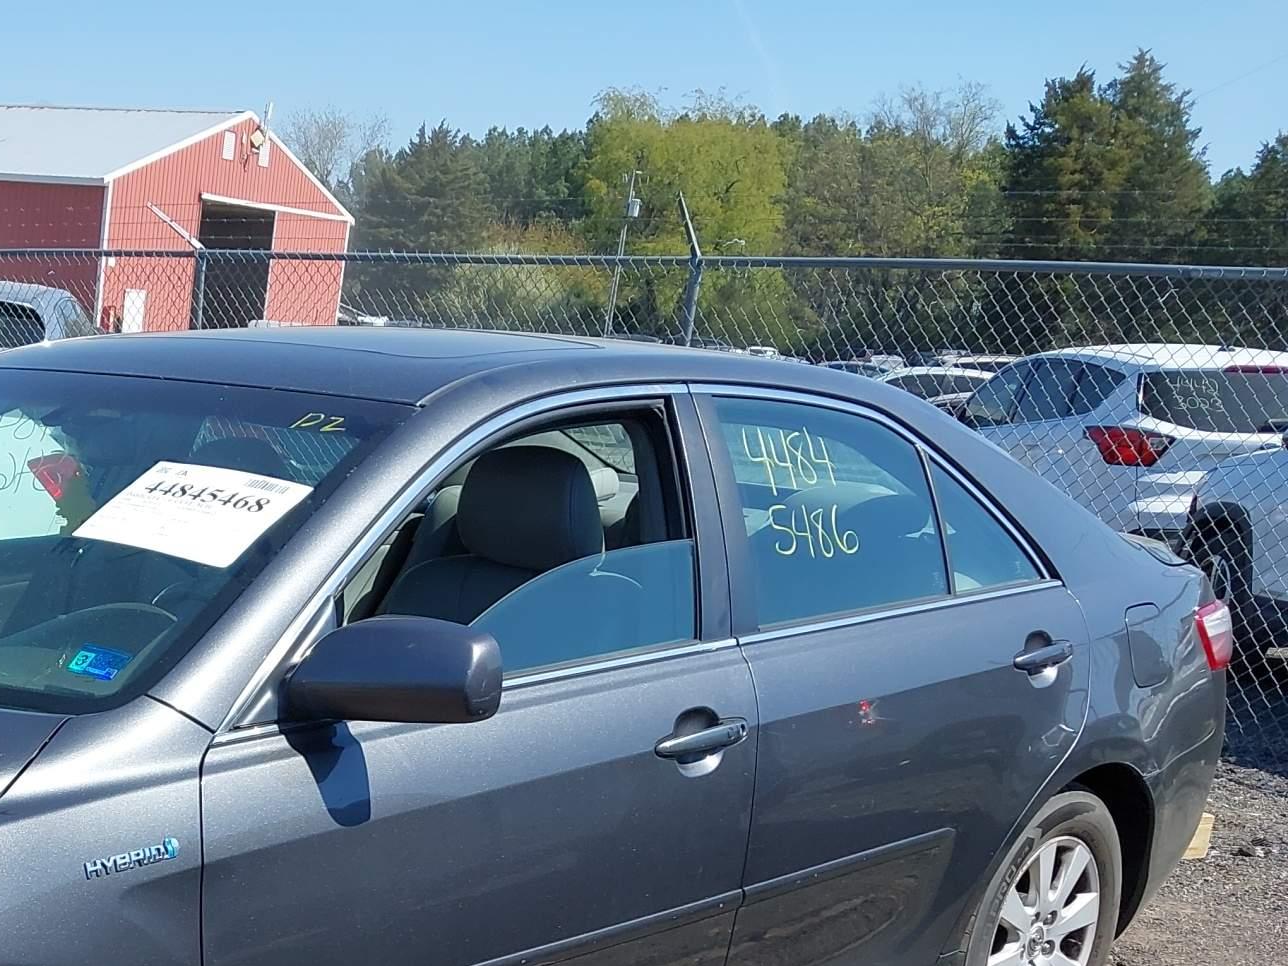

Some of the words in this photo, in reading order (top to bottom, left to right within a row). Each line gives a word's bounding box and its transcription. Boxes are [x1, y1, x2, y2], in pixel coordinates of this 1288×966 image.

[741, 426, 838, 497] 4484
[144, 480, 271, 513] 44845468
[768, 503, 860, 559] 5486
[83, 845, 166, 880] HYBRID
